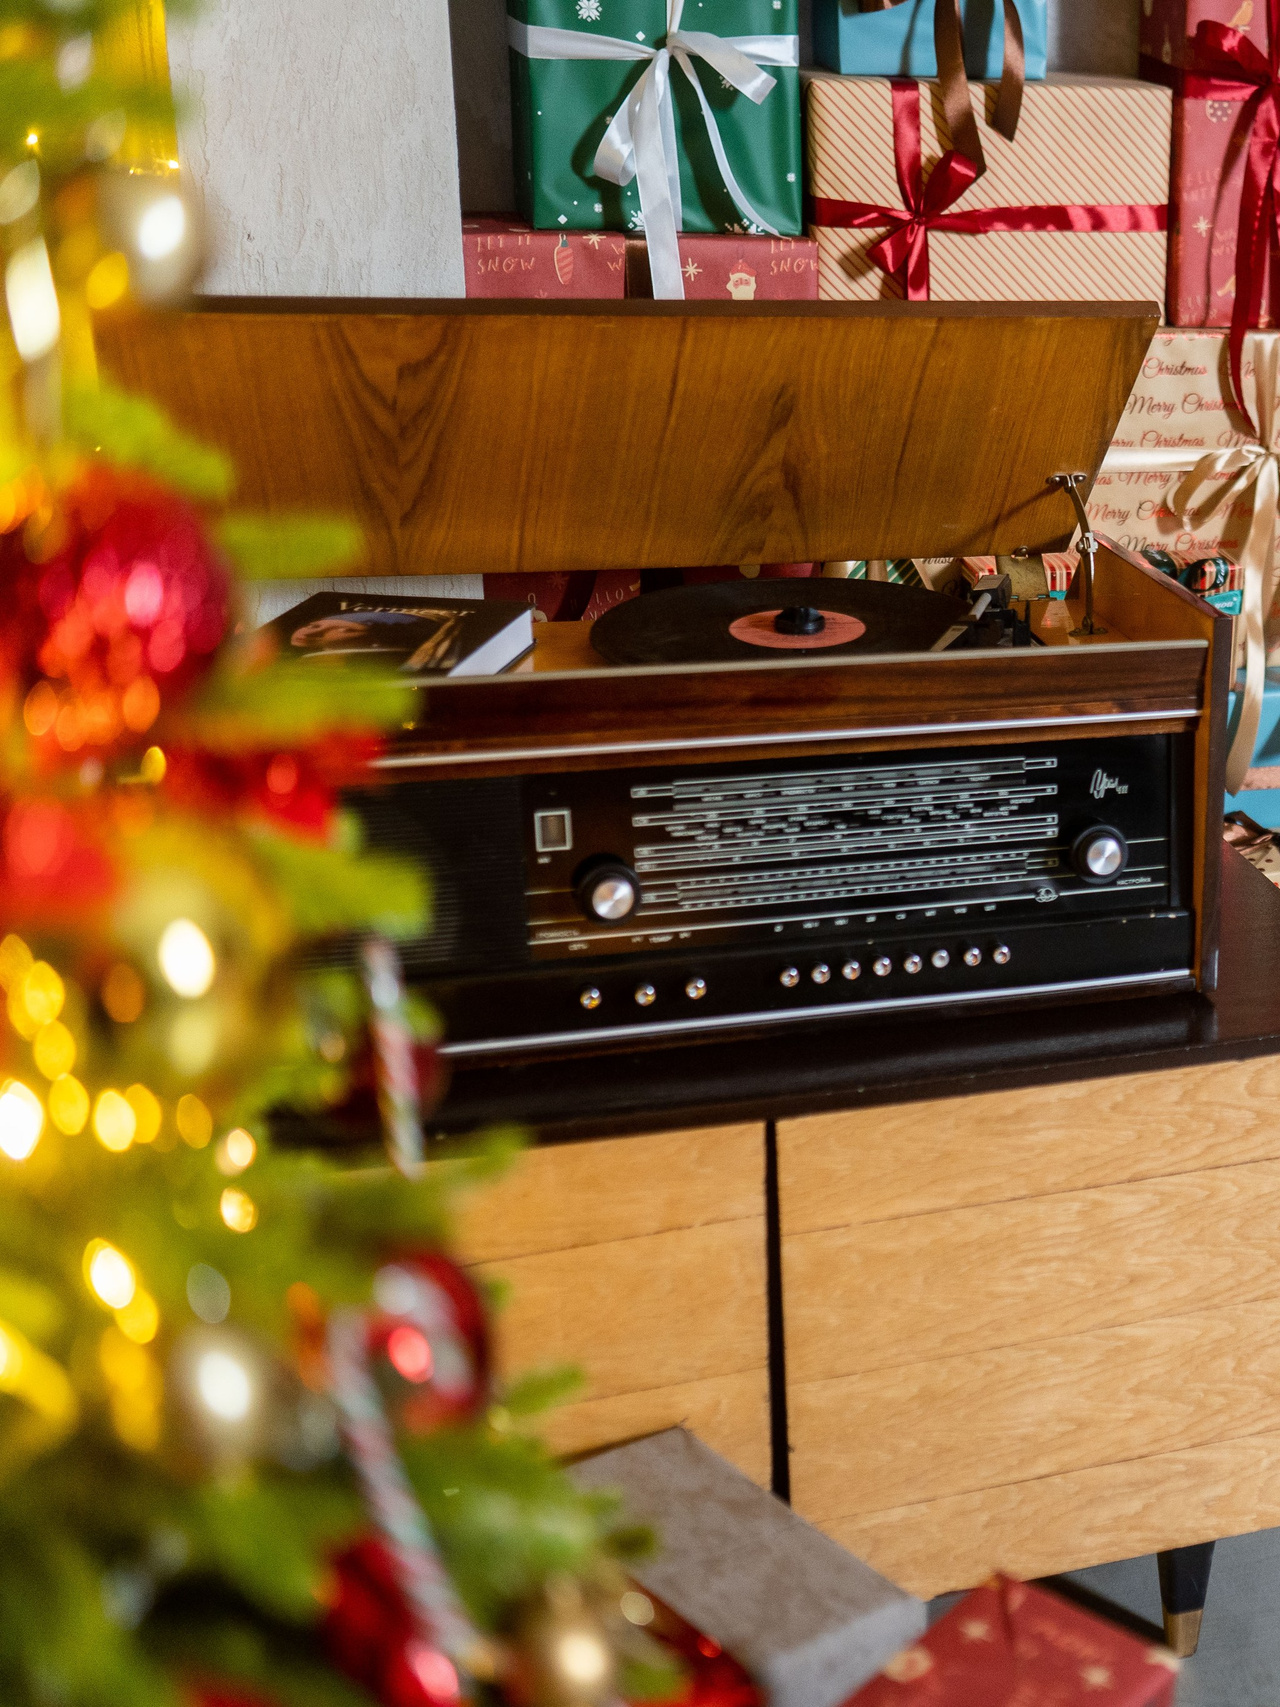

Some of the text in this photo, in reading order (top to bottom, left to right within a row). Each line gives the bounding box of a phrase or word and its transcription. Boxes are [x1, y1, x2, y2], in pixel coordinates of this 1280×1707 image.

[477, 256, 535, 275] SNOW
[1142, 357, 1208, 379] Christmas
[1125, 394, 1176, 419] Merry
[1140, 430, 1205, 448] Christmas
[1118, 471, 1172, 488] Merry
[1086, 502, 1131, 525] Merry
[1174, 532, 1239, 551] Christmas
[339, 602, 476, 617] Vermeer
